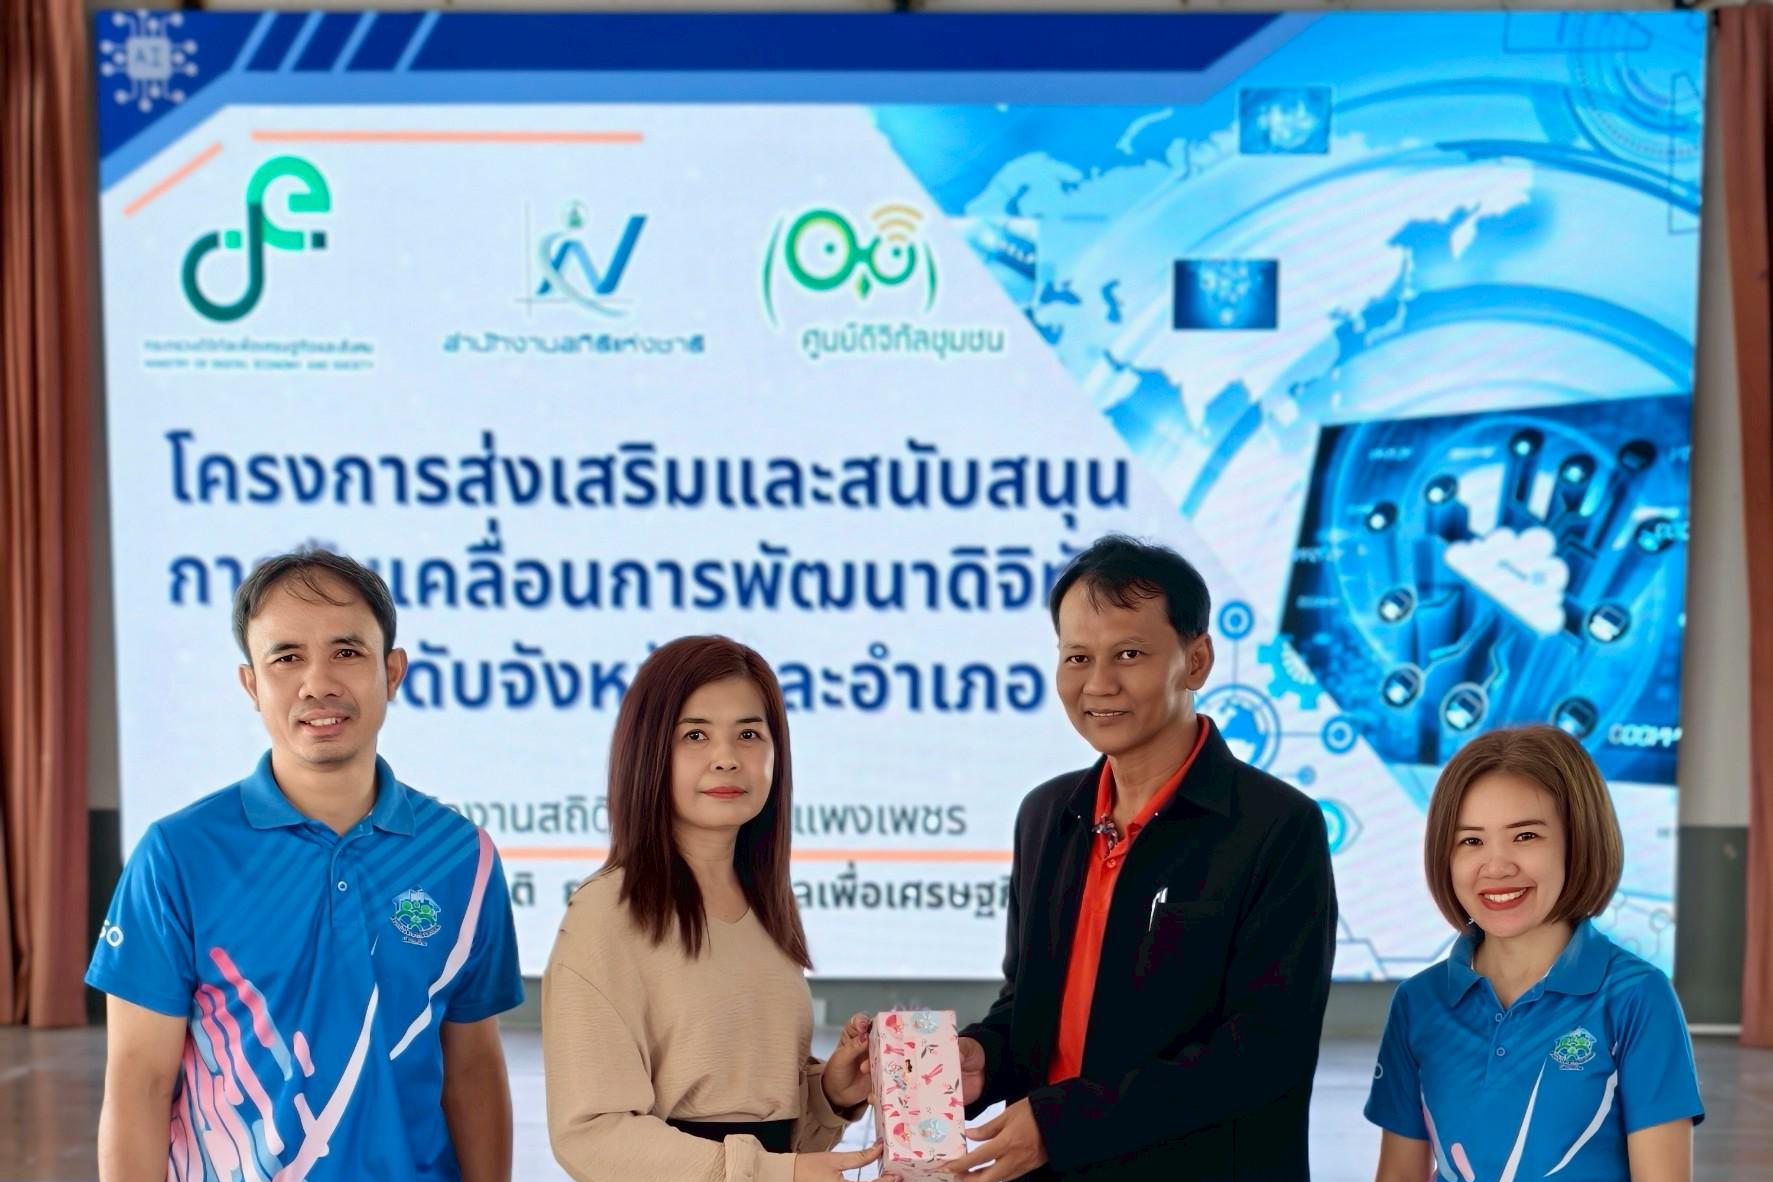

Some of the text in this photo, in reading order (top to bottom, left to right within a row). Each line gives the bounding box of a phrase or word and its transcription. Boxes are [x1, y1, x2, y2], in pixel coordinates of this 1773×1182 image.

[164, 429, 1129, 529] โครงการส่งเสริมและสนับสนุน
